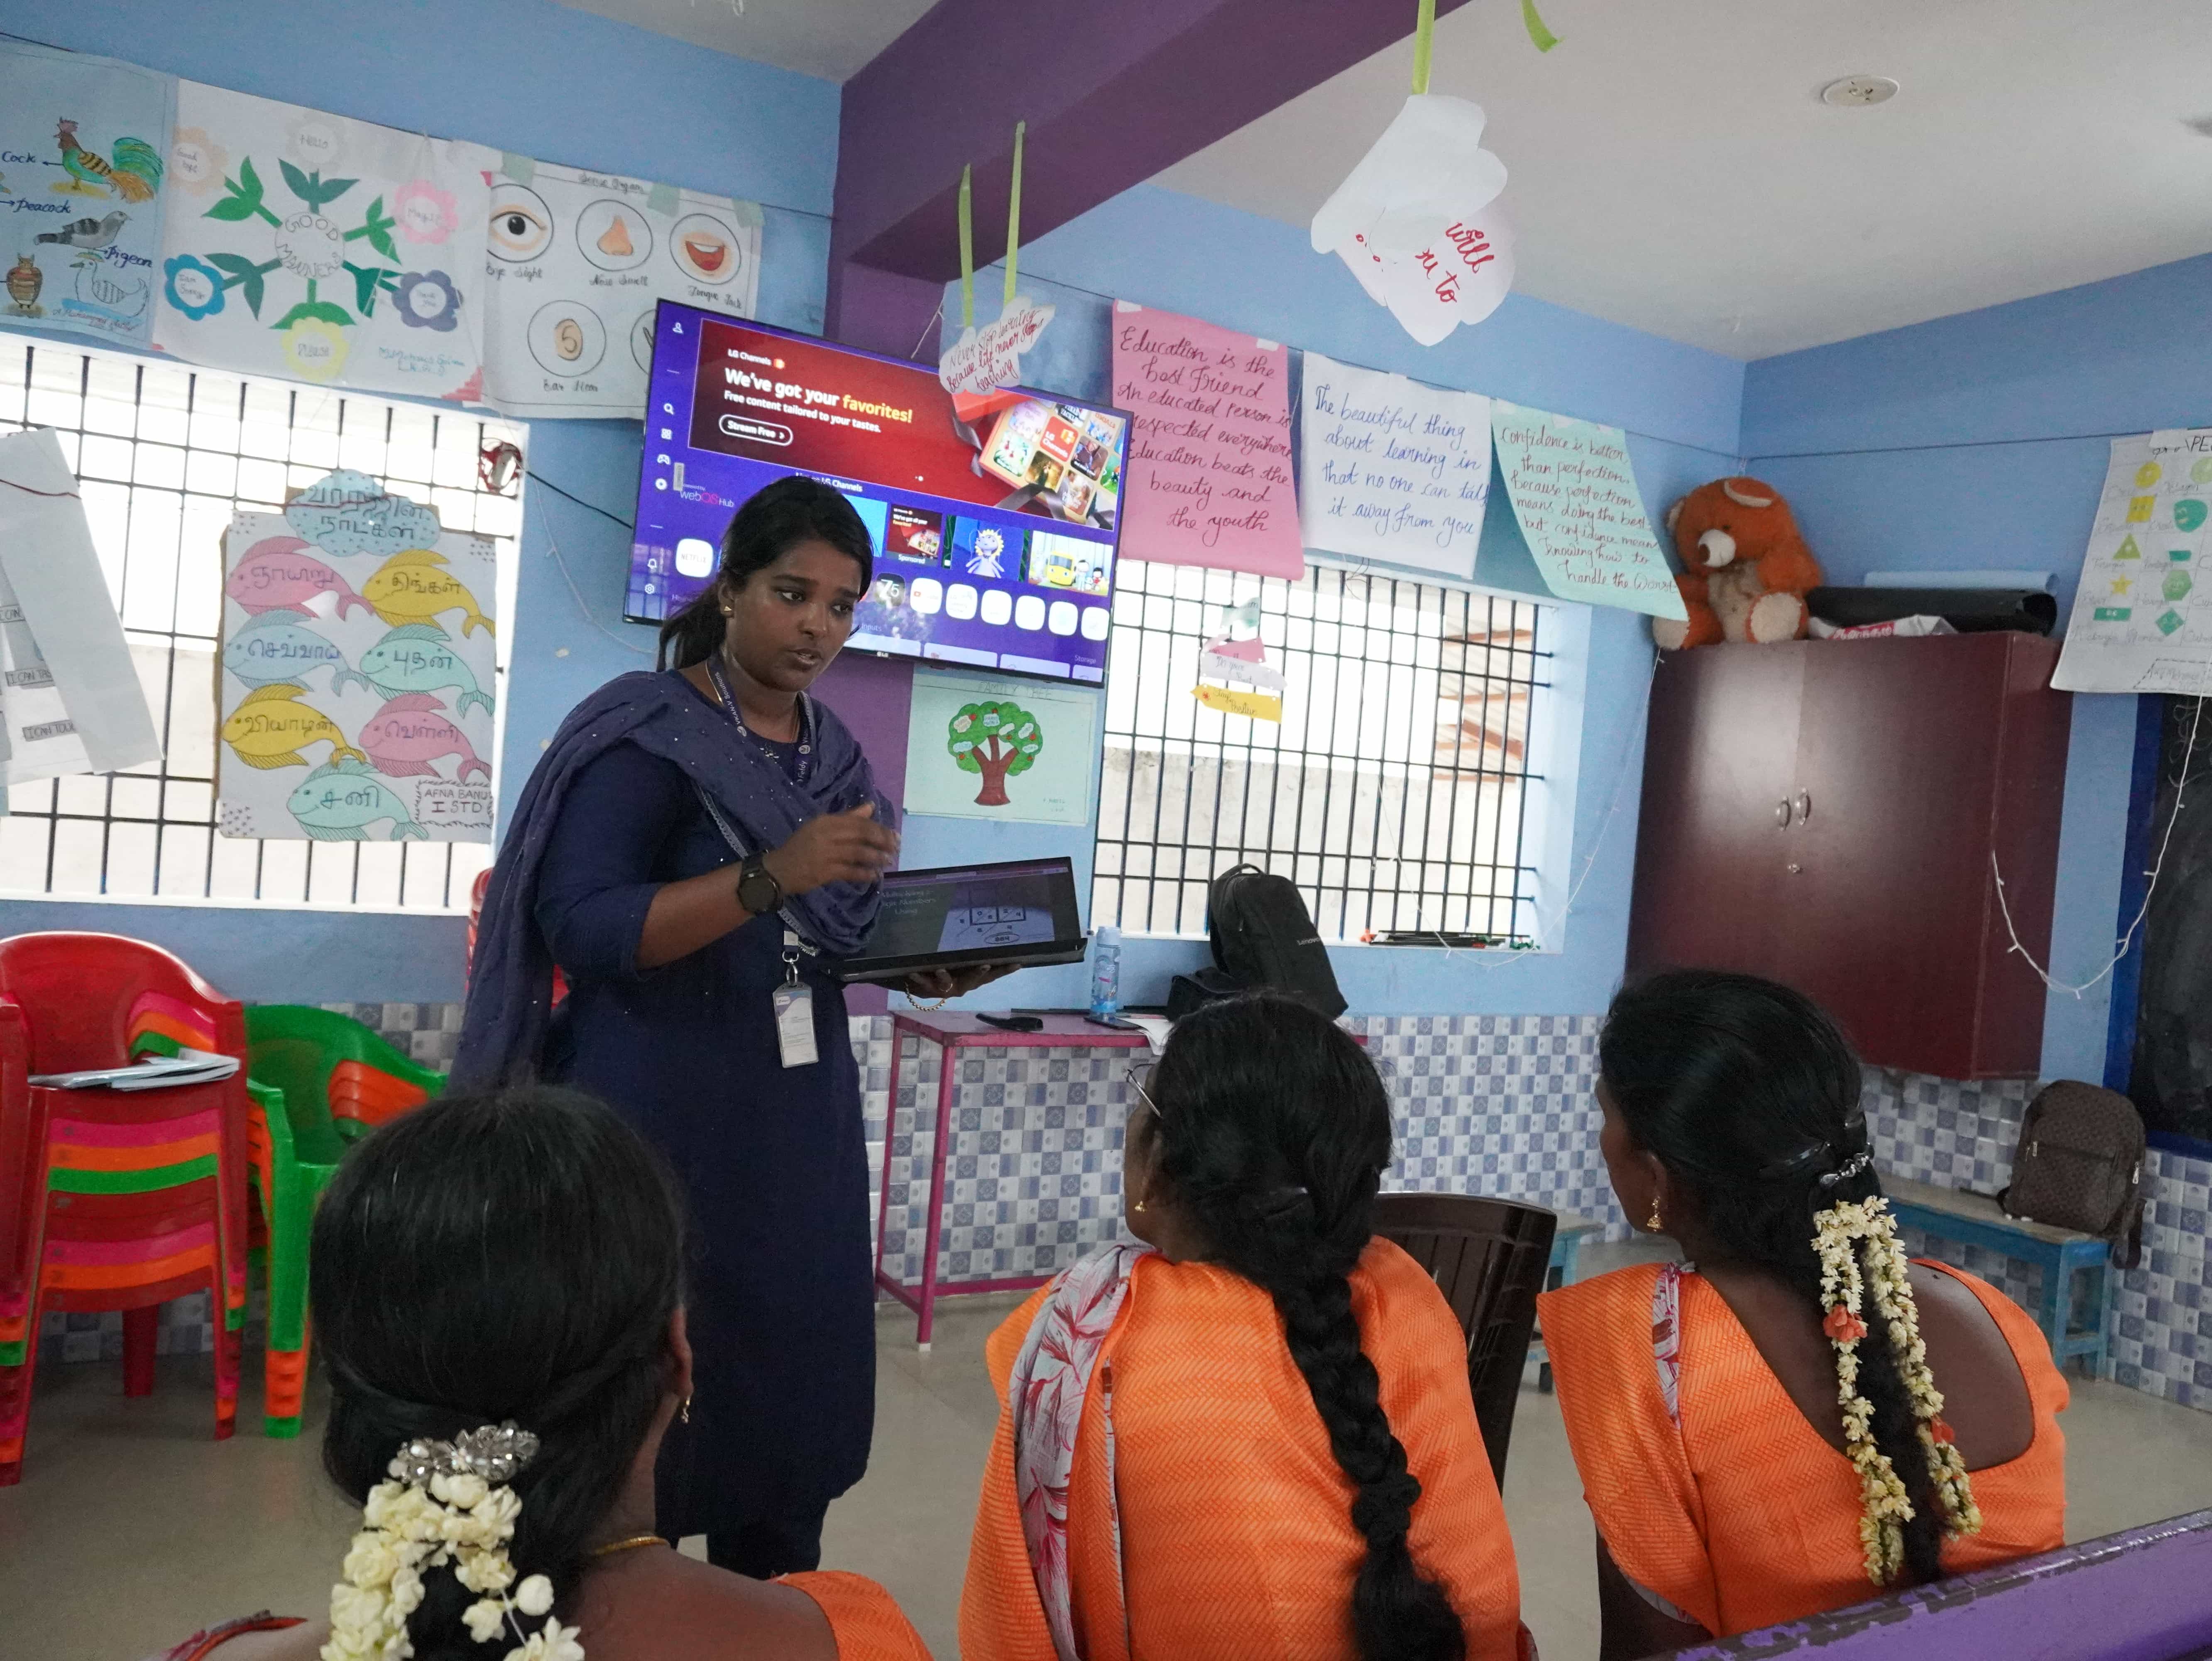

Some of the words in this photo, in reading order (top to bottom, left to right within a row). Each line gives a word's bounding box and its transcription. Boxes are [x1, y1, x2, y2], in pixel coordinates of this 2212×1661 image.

[2, 151, 37, 164] Cock
[285, 215, 338, 240] GOOD
[1436, 271, 1460, 303] to
[727, 349, 739, 358] LG
[740, 353, 771, 366] Channels
[1120, 326, 1208, 363] Education
[1217, 348, 1236, 369] is
[1245, 355, 1275, 379] the
[543, 379, 565, 392] Ear
[724, 367, 772, 392] We've
[776, 382, 802, 398] got
[804, 389, 840, 406] your
[842, 394, 913, 423] favorites!
[724, 390, 744, 404] Free
[746, 395, 782, 412] content
[783, 403, 817, 420] tailored
[819, 411, 829, 421] to
[830, 415, 851, 426] your
[852, 418, 881, 433] tastes.
[1148, 389, 1221, 416] educated
[1315, 384, 1334, 414] The
[1341, 392, 1417, 435] beautiful
[1423, 414, 1466, 451] thing
[727, 420, 757, 435] Stream
[758, 426, 776, 439] Free
[1045, 431, 1055, 441] LG
[1324, 424, 1375, 452] about
[1383, 439, 1446, 479] learning
[1521, 455, 1552, 474] than
[1260, 463, 1290, 487] the
[1322, 461, 1358, 485] that
[1366, 472, 1385, 488] no
[1390, 476, 1414, 492] one
[1420, 483, 1451, 498] can
[832, 480, 863, 492] Channels
[1150, 470, 1214, 511] beauty
[1221, 486, 1272, 502] and
[680, 491, 718, 505] webOS
[719, 498, 734, 507] Hub
[1328, 498, 1347, 517] it
[1353, 504, 1391, 536] away
[1436, 517, 1475, 548] you
[1524, 514, 1548, 532] but
[1597, 507, 1615, 522] the
[1167, 506, 1198, 530] the
[1202, 510, 1269, 548] youth
[681, 554, 707, 564] NETFLIX
[898, 554, 926, 564] Sponsored
[1595, 543, 1622, 563] how
[1634, 551, 1650, 565] to
[1613, 574, 1629, 589] the
[861, 623, 881, 632] Inputs
[1075, 655, 1096, 664] Storage
[34, 725, 52, 737] CAN
[320, 786, 379, 809] சனி
[424, 789, 455, 798] AFNA
[432, 801, 445, 813] I
[450, 801, 482, 813] STD
